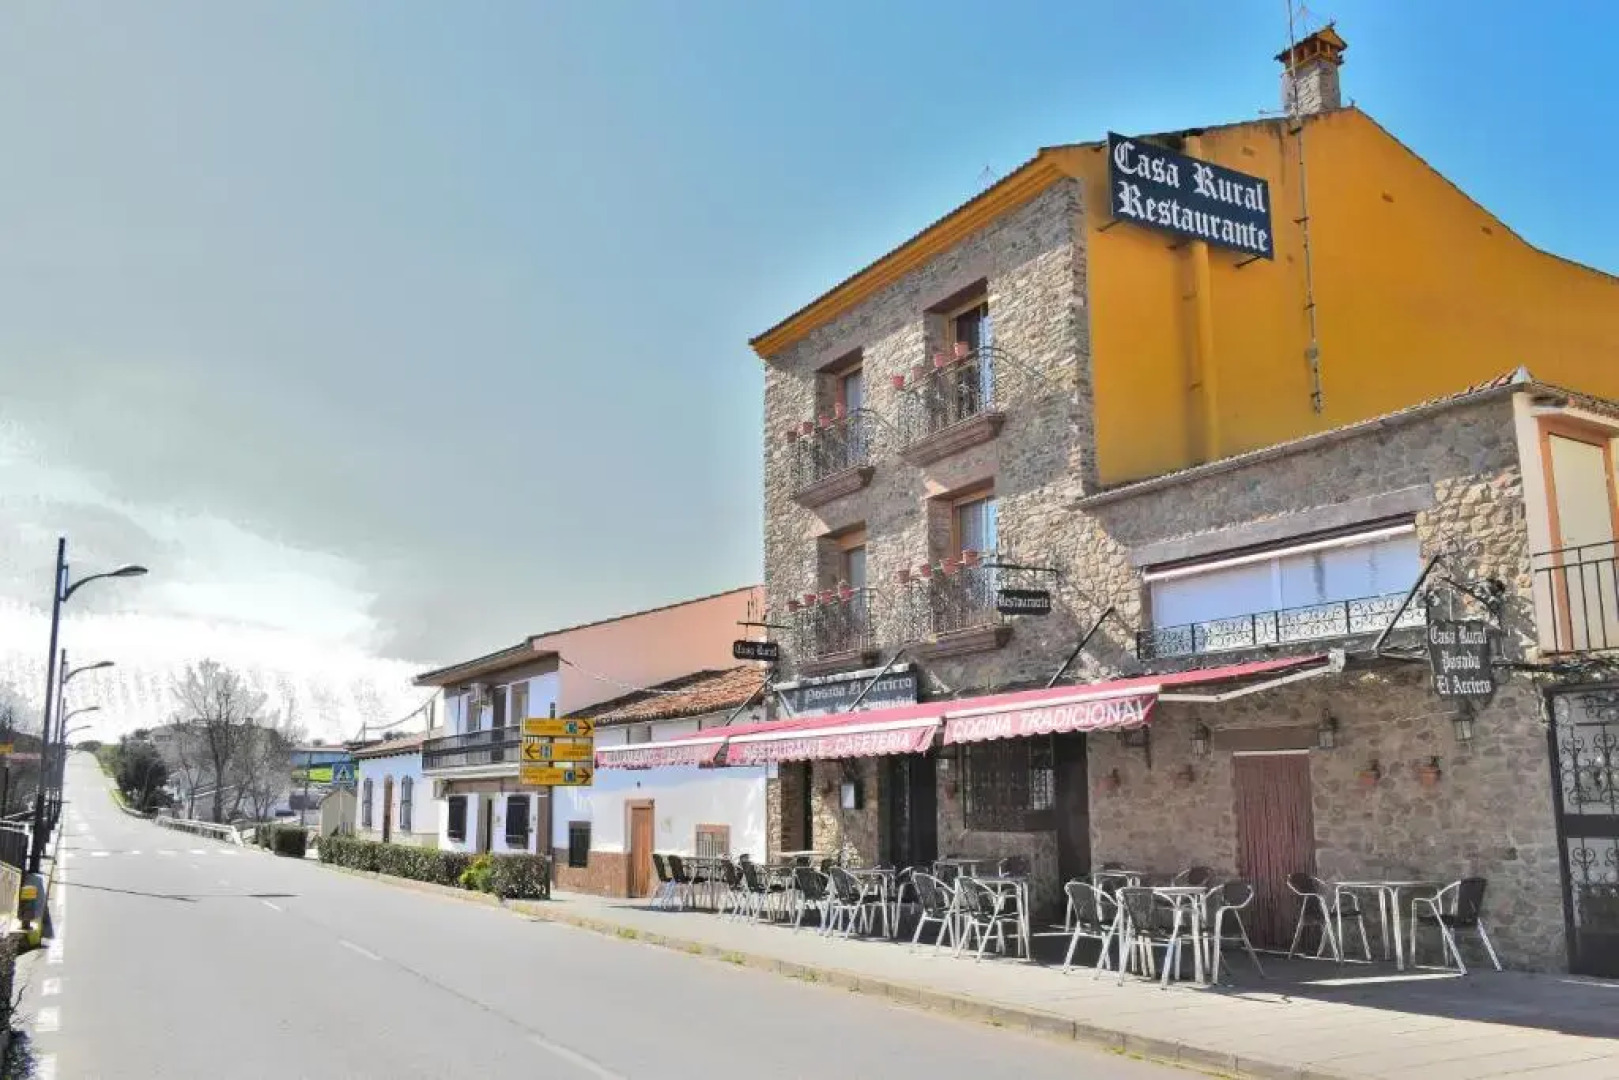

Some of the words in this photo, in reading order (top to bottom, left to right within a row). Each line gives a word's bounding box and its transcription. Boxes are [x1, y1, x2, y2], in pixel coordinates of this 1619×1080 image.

[1114, 141, 1180, 188] Casa
[1193, 162, 1267, 213] Rural
[1116, 180, 1269, 252] Restaurante
[1430, 625, 1456, 645] Casa
[1457, 625, 1487, 645] Rural
[1441, 649, 1481, 673] Posada
[1436, 674, 1451, 695] El
[1452, 674, 1492, 695] Arriero
[953, 713, 1011, 740] COCINA
[834, 731, 911, 754] CAFETERIA
